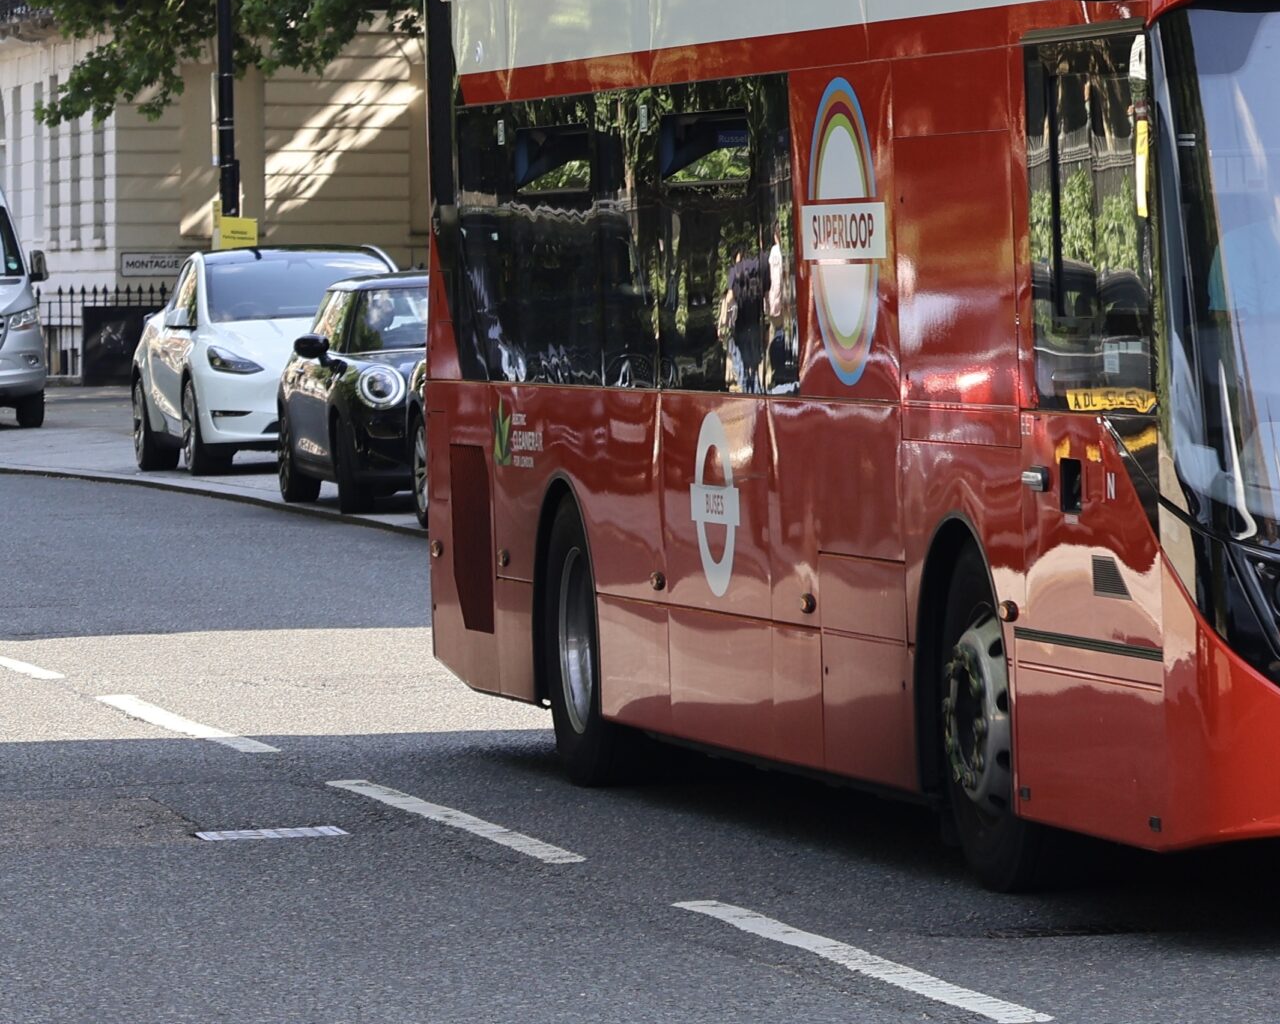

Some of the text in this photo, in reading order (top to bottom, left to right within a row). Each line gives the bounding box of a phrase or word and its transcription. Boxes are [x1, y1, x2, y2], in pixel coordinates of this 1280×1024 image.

[812, 213, 874, 251] SUPERLOOP
[126, 260, 180, 269] MONTAGUE
[705, 494, 724, 516] BUSES
